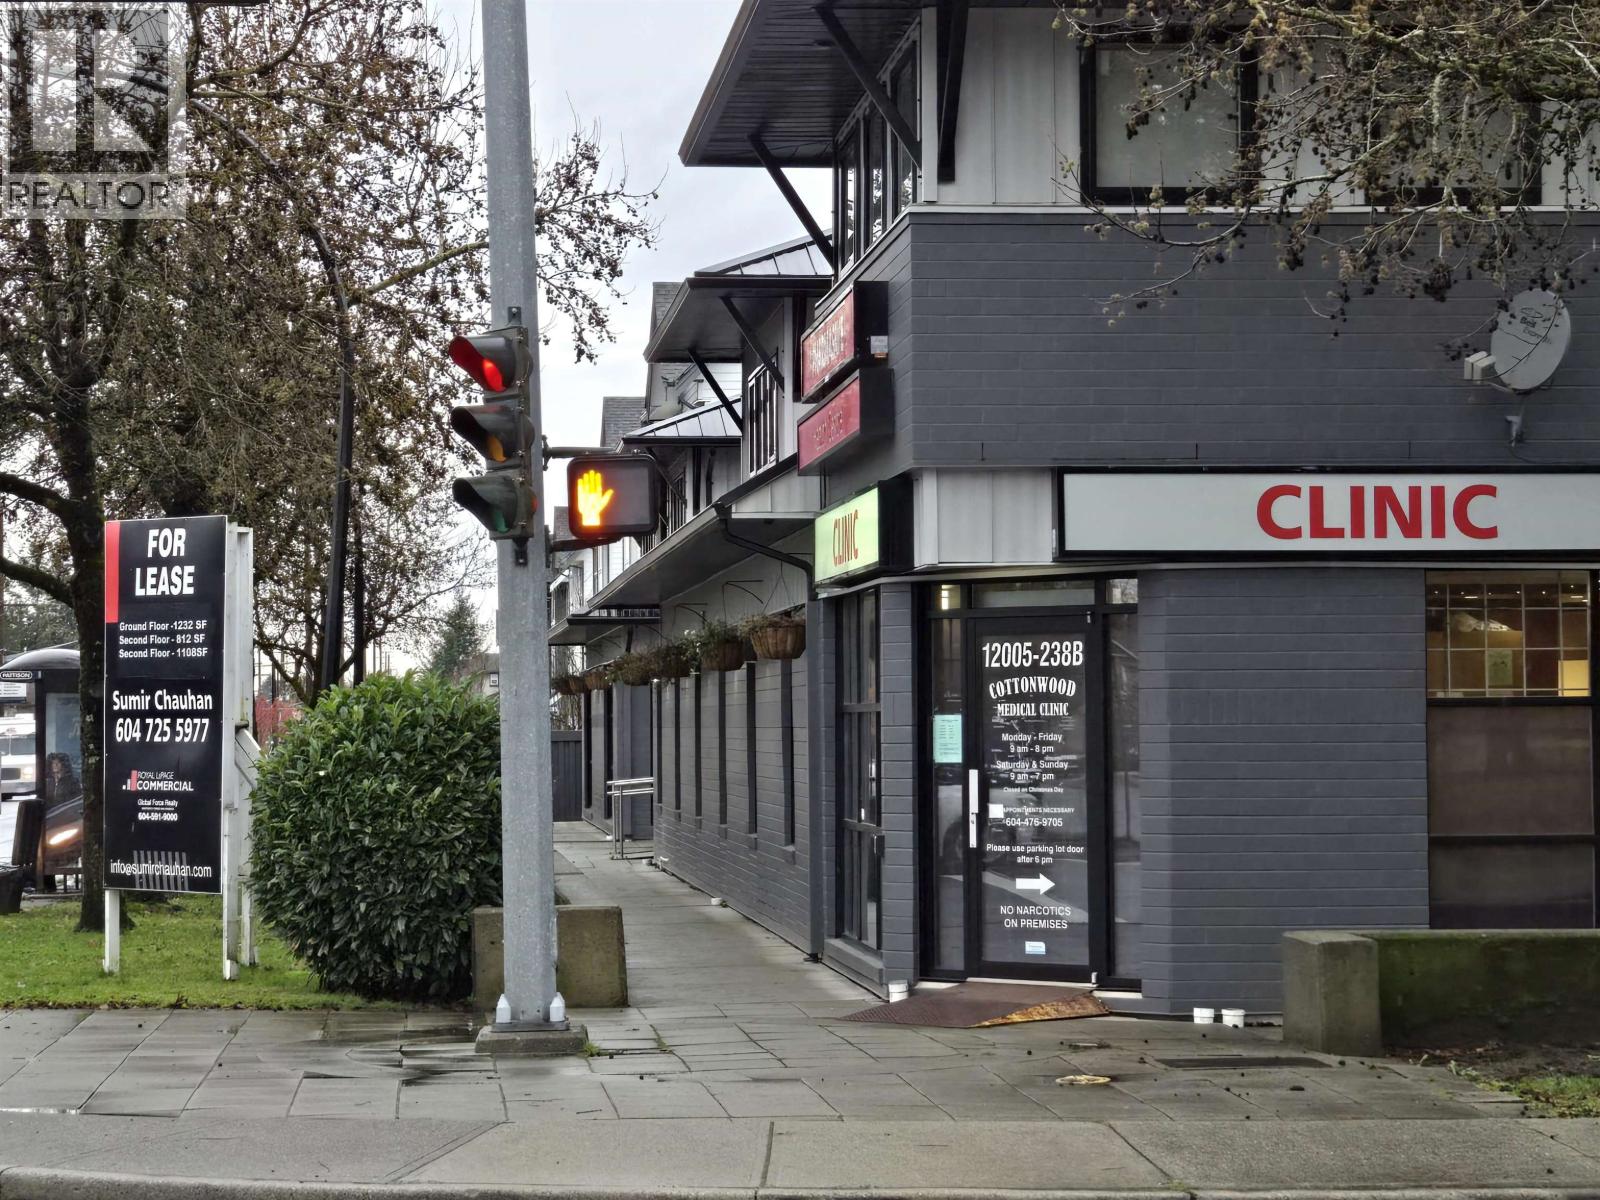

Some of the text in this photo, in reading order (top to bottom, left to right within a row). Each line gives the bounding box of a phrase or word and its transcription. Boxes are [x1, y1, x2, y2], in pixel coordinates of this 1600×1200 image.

[1257, 484, 1499, 540] CLINIC
[147, 528, 186, 557] FOR
[833, 509, 858, 567] CLINIC
[135, 565, 195, 596] LEASE
[119, 622, 147, 631] Ground
[149, 621, 169, 630] Floor
[195, 620, 207, 629] SF
[119, 635, 147, 645] Second
[150, 635, 170, 644] Floor
[176, 634, 191, 644] 812
[193, 634, 205, 643] SF
[119, 649, 148, 658] Second
[150, 648, 170, 657] Floor
[982, 640, 1083, 668] 12005-238B
[989, 676, 1076, 699] COTTONWOOD
[112, 689, 213, 711] Sumir Chauhan
[997, 702, 1069, 716] MEDICAL CLINIC
[115, 717, 210, 742] 604 725 5977
[1001, 733, 1032, 742] Monday
[1038, 733, 1063, 742] Friday
[1009, 745, 1015, 753] 9
[1035, 745, 1040, 753] 8
[1042, 746, 1054, 754] pm
[996, 760, 1068, 770] Saturday & Sunday
[137, 771, 155, 779] ROYAL
[1009, 772, 1015, 780] 9
[1042, 773, 1054, 782] pm
[136, 781, 194, 791] COMMERCIAL
[164, 799, 178, 808] Realty
[138, 812, 178, 821] 604-591-9000
[1005, 817, 1063, 827] 604-476-9705
[986, 844, 1010, 852] Please
[1026, 844, 1054, 854] parking
[1055, 845, 1065, 853] lot
[1066, 845, 1084, 853] door
[1041, 857, 1053, 865] pm
[110, 859, 212, 877] info@sumirchauhan.com
[1000, 905, 1072, 916] NO NARCOTICS
[1004, 918, 1068, 929] ON PREMISES
